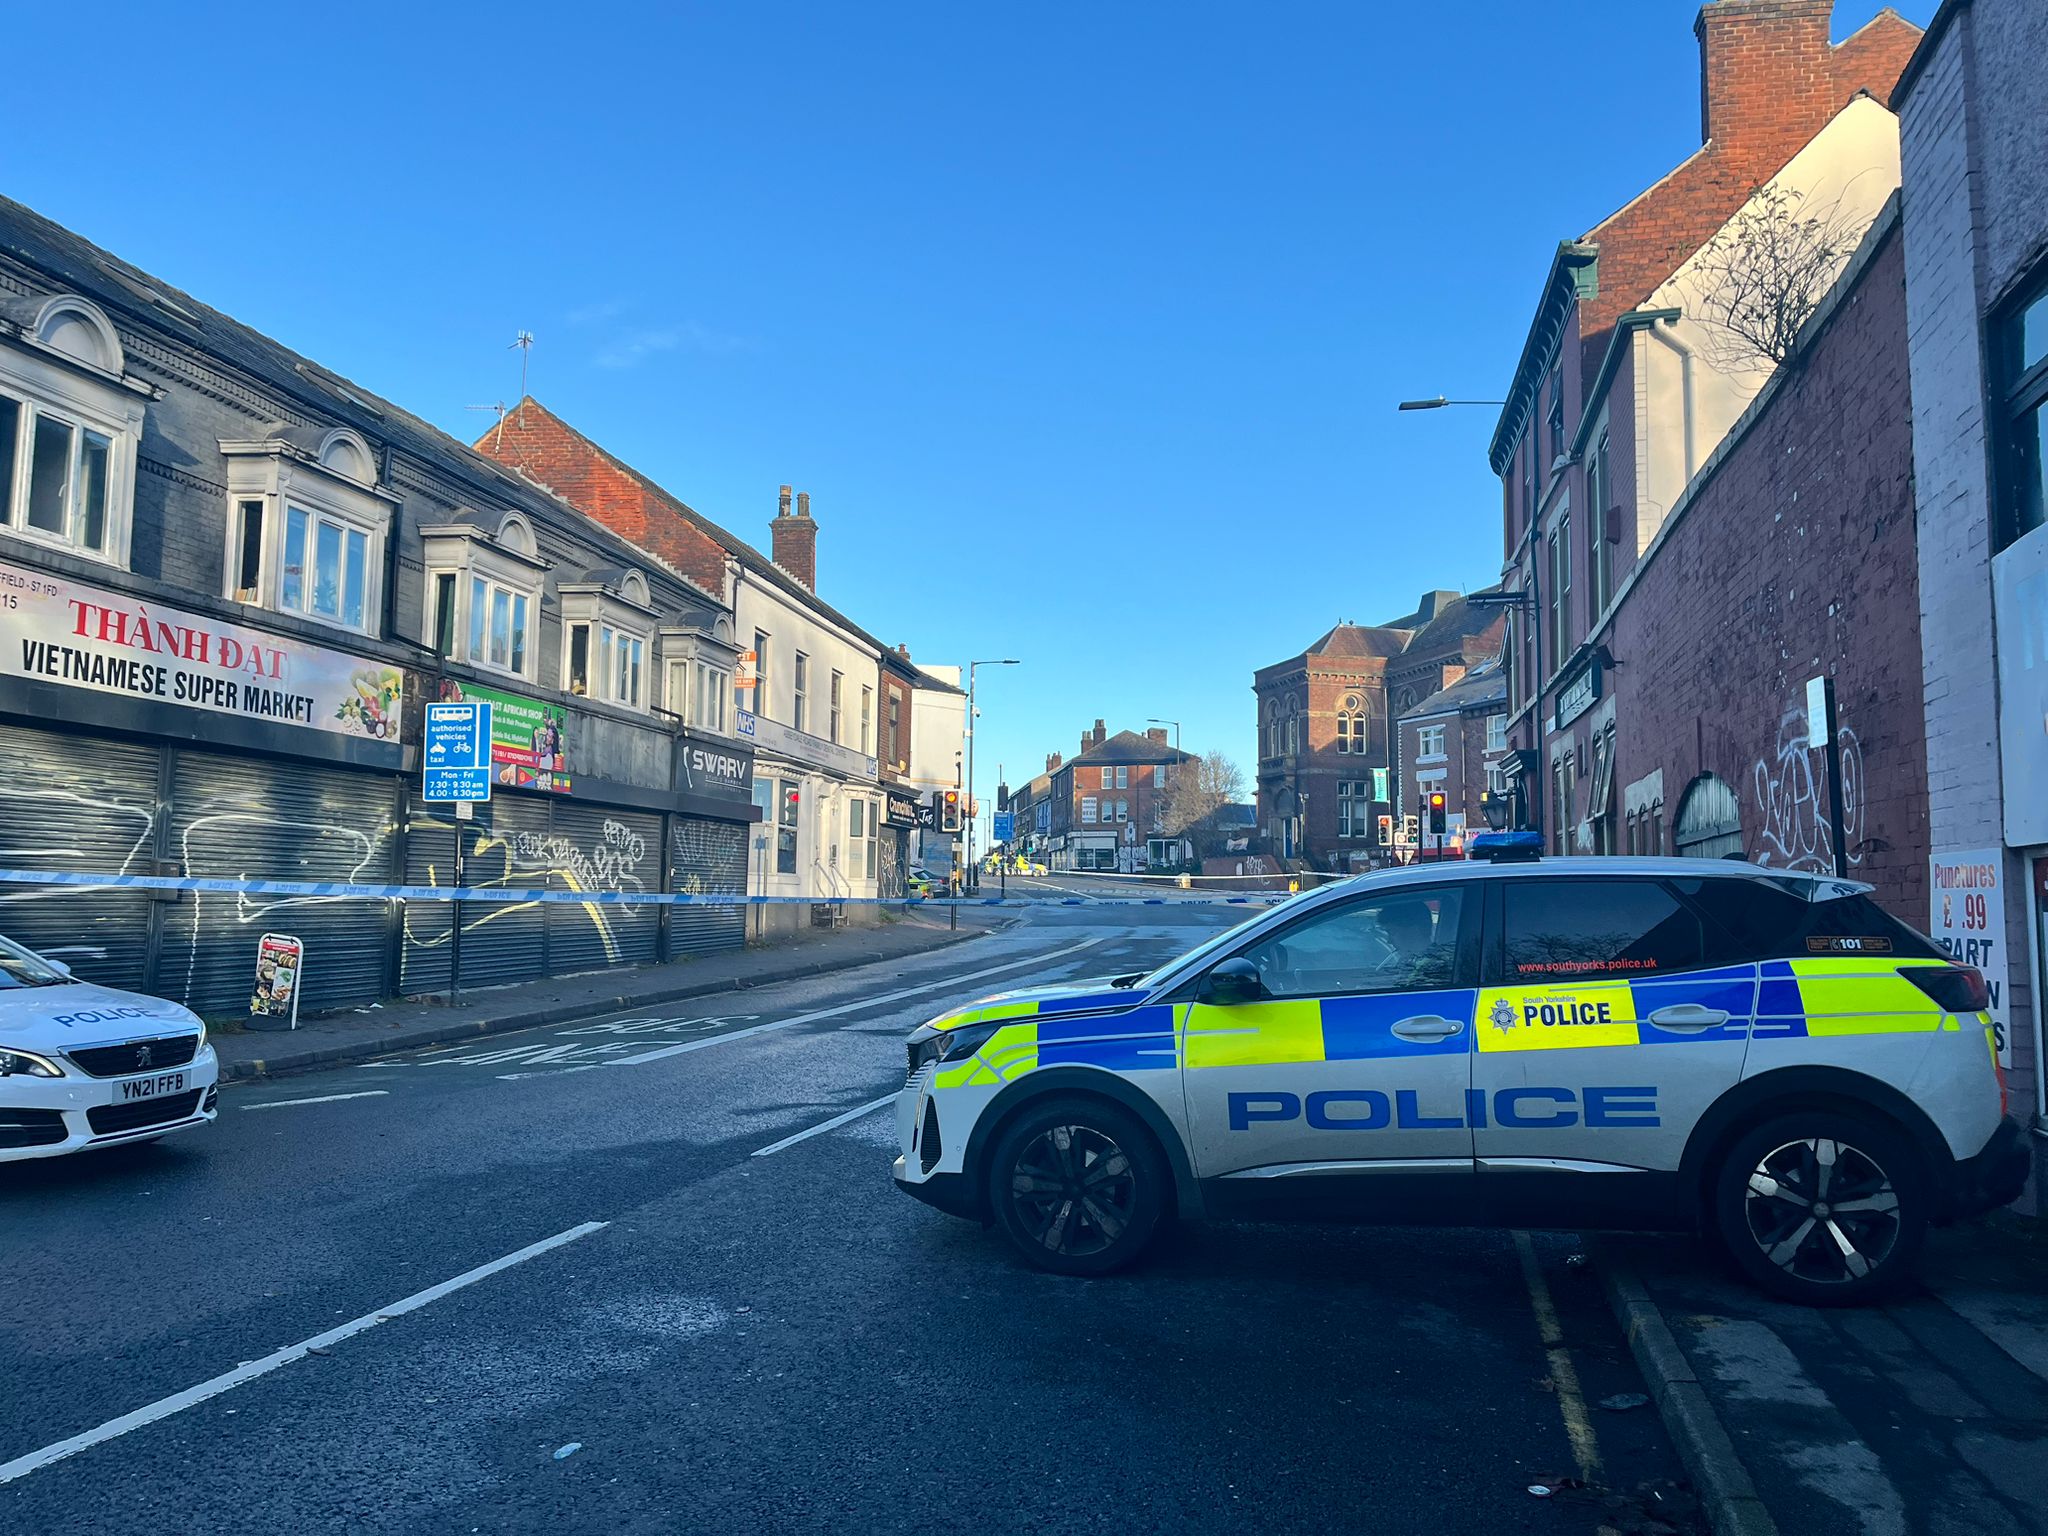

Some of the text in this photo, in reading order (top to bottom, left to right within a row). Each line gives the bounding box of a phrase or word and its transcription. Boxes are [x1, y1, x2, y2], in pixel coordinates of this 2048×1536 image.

[0, 572, 24, 588] FIELD
[31, 580, 41, 592] S7
[43, 584, 58, 596] 1FD
[68, 599, 288, 681] THÀNH ĐẠT
[22, 638, 315, 723] VIETNAMESE SUPER MARKET
[431, 724, 472, 733] authorised
[737, 712, 754, 735] NHS
[435, 733, 467, 741] vehicles
[440, 771, 458, 779] Mon
[692, 749, 747, 779] SWARV
[429, 781, 448, 789] 7.30
[452, 781, 471, 789] 9.30
[471, 790, 485, 799] pm
[1934, 863, 1996, 890] Punctures
[1943, 893, 1987, 930] £ .99
[1840, 938, 1862, 949] 101
[1517, 957, 1657, 974] www.southyorks.police.uk
[1522, 995, 1577, 1004] South Yorkshire
[51, 1006, 159, 1028] POLICE
[555, 1015, 760, 1035] BUS
[1524, 1002, 1612, 1027] POLICE
[121, 1073, 184, 1100] YN21 FFB
[1227, 1086, 1661, 1131] POLICE
